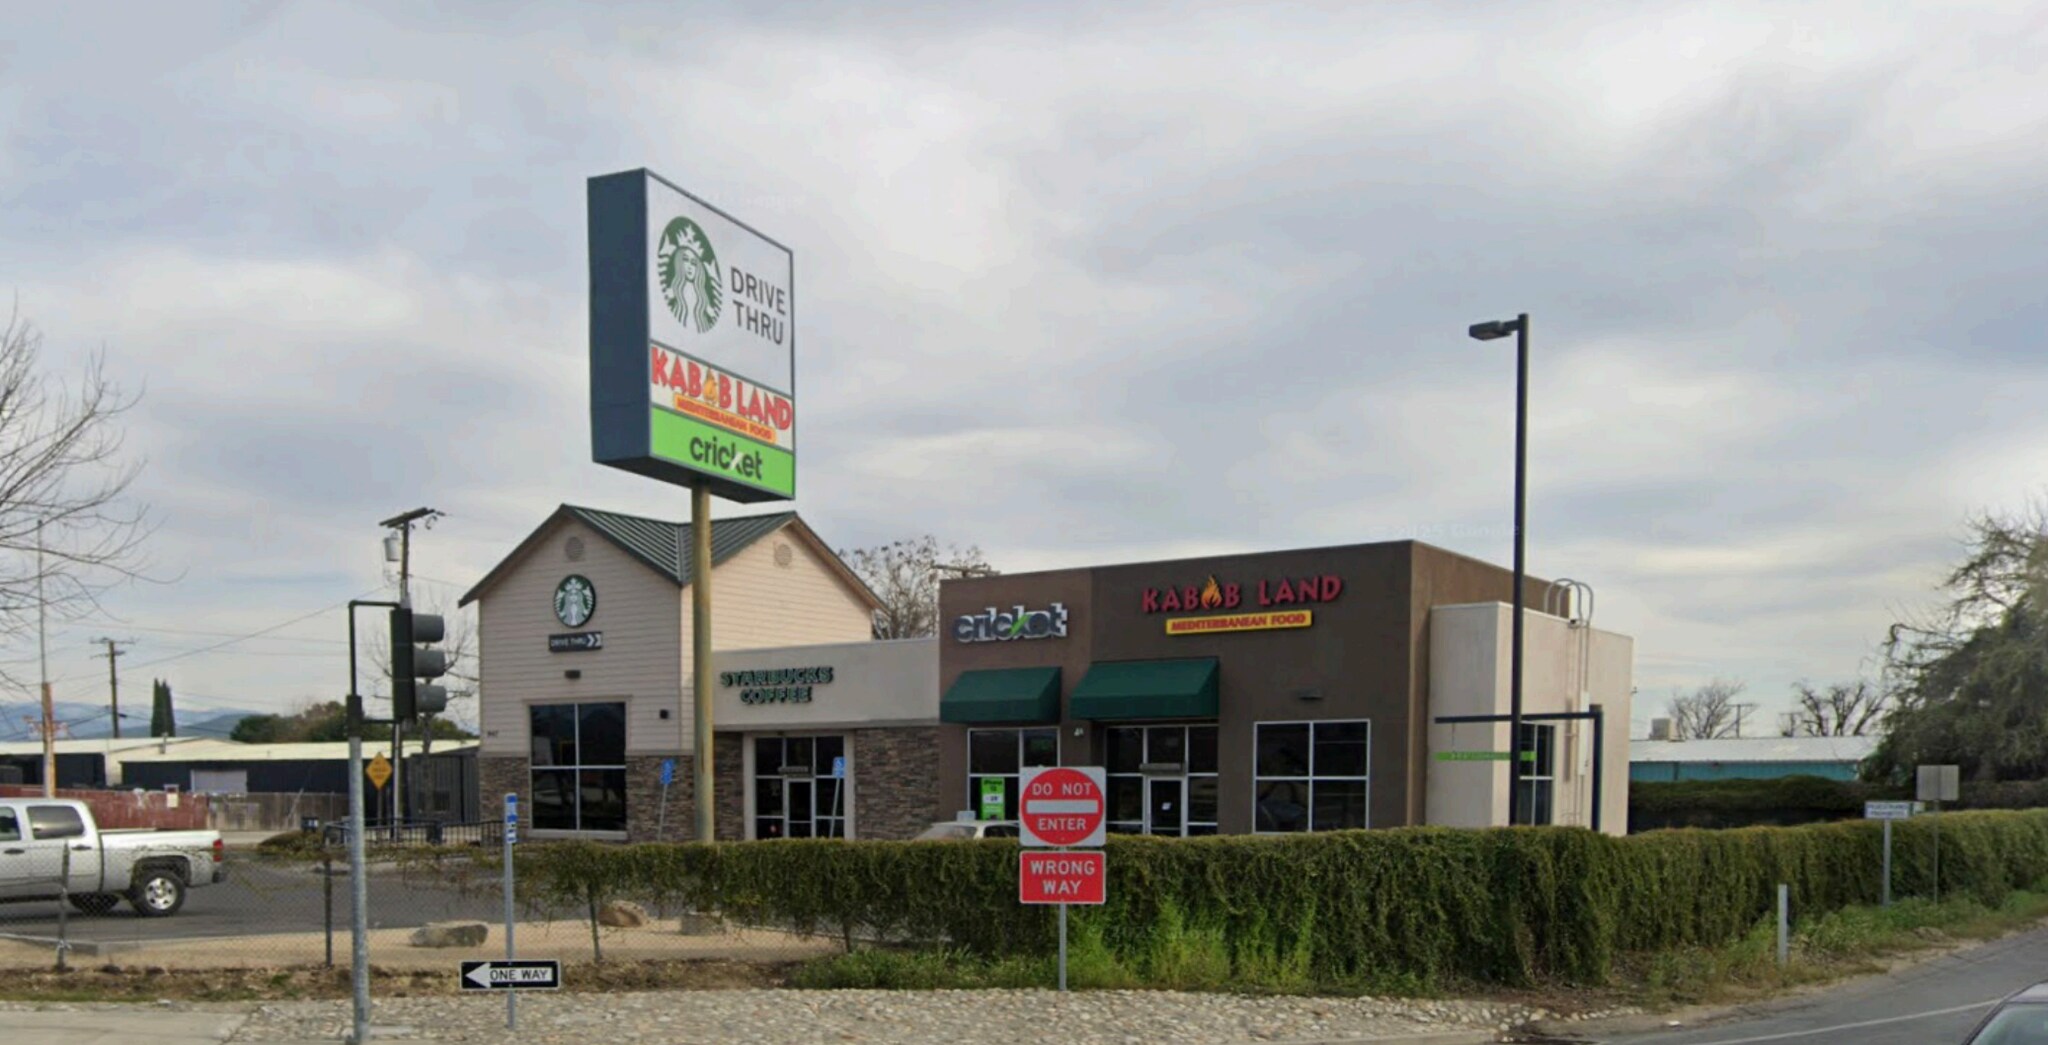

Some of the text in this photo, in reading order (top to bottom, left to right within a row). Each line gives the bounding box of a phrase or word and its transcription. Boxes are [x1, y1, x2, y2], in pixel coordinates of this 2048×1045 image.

[731, 266, 786, 316] DRIVE
[733, 299, 784, 345] THRU
[736, 380, 793, 430] LAND
[690, 436, 763, 479] cricket
[1258, 575, 1344, 605] LAND
[953, 603, 1068, 643] cricket
[1171, 611, 1306, 631] MEDITERRANEAN FOOD
[720, 666, 834, 687] STARBUCKS
[740, 686, 812, 704] COFFEE
[1032, 783, 1092, 795] DO NOT
[1037, 818, 1086, 831] ENTER
[1030, 861, 1095, 875] WRONG
[1042, 880, 1081, 894] WAY
[490, 970, 547, 980] ONE WAY
